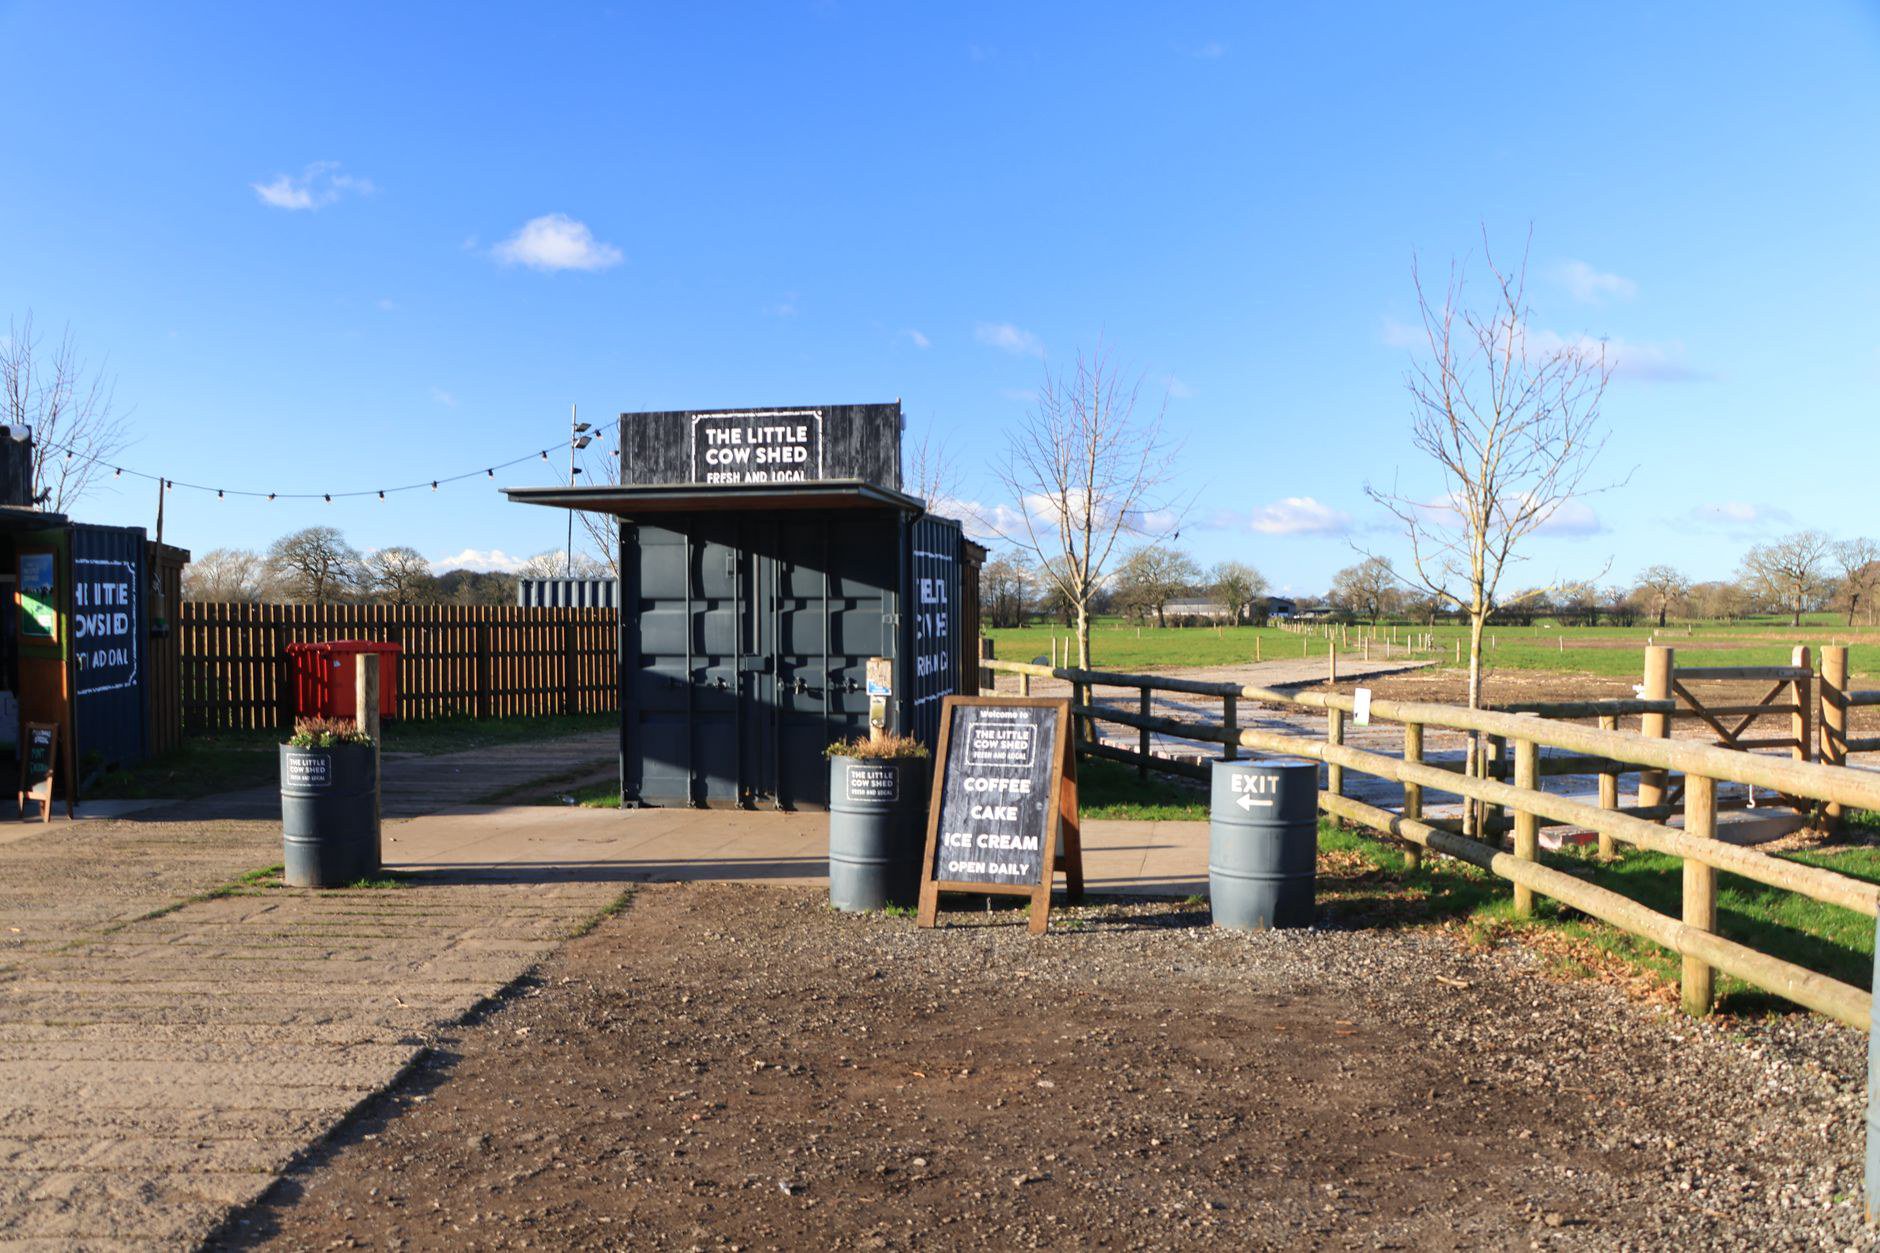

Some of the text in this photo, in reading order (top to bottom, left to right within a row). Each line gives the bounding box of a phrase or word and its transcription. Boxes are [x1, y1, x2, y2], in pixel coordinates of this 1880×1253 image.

[705, 426, 807, 445] THE LITTLE
[705, 447, 807, 465] COW SHED
[707, 470, 805, 484] FRESH AND LOCAL
[980, 710, 1028, 719] Welcome to
[975, 730, 1029, 740] THE LITTLE
[974, 740, 1028, 750] COW SHED
[851, 771, 893, 779] THE LITTLE
[851, 779, 869, 787] COW
[963, 777, 1031, 793] COFFEE
[1231, 773, 1280, 794] EXIT
[971, 805, 1018, 821] CAKE
[944, 832, 1039, 851] ICE CREAM
[948, 861, 1029, 876] OPEN DAILY
